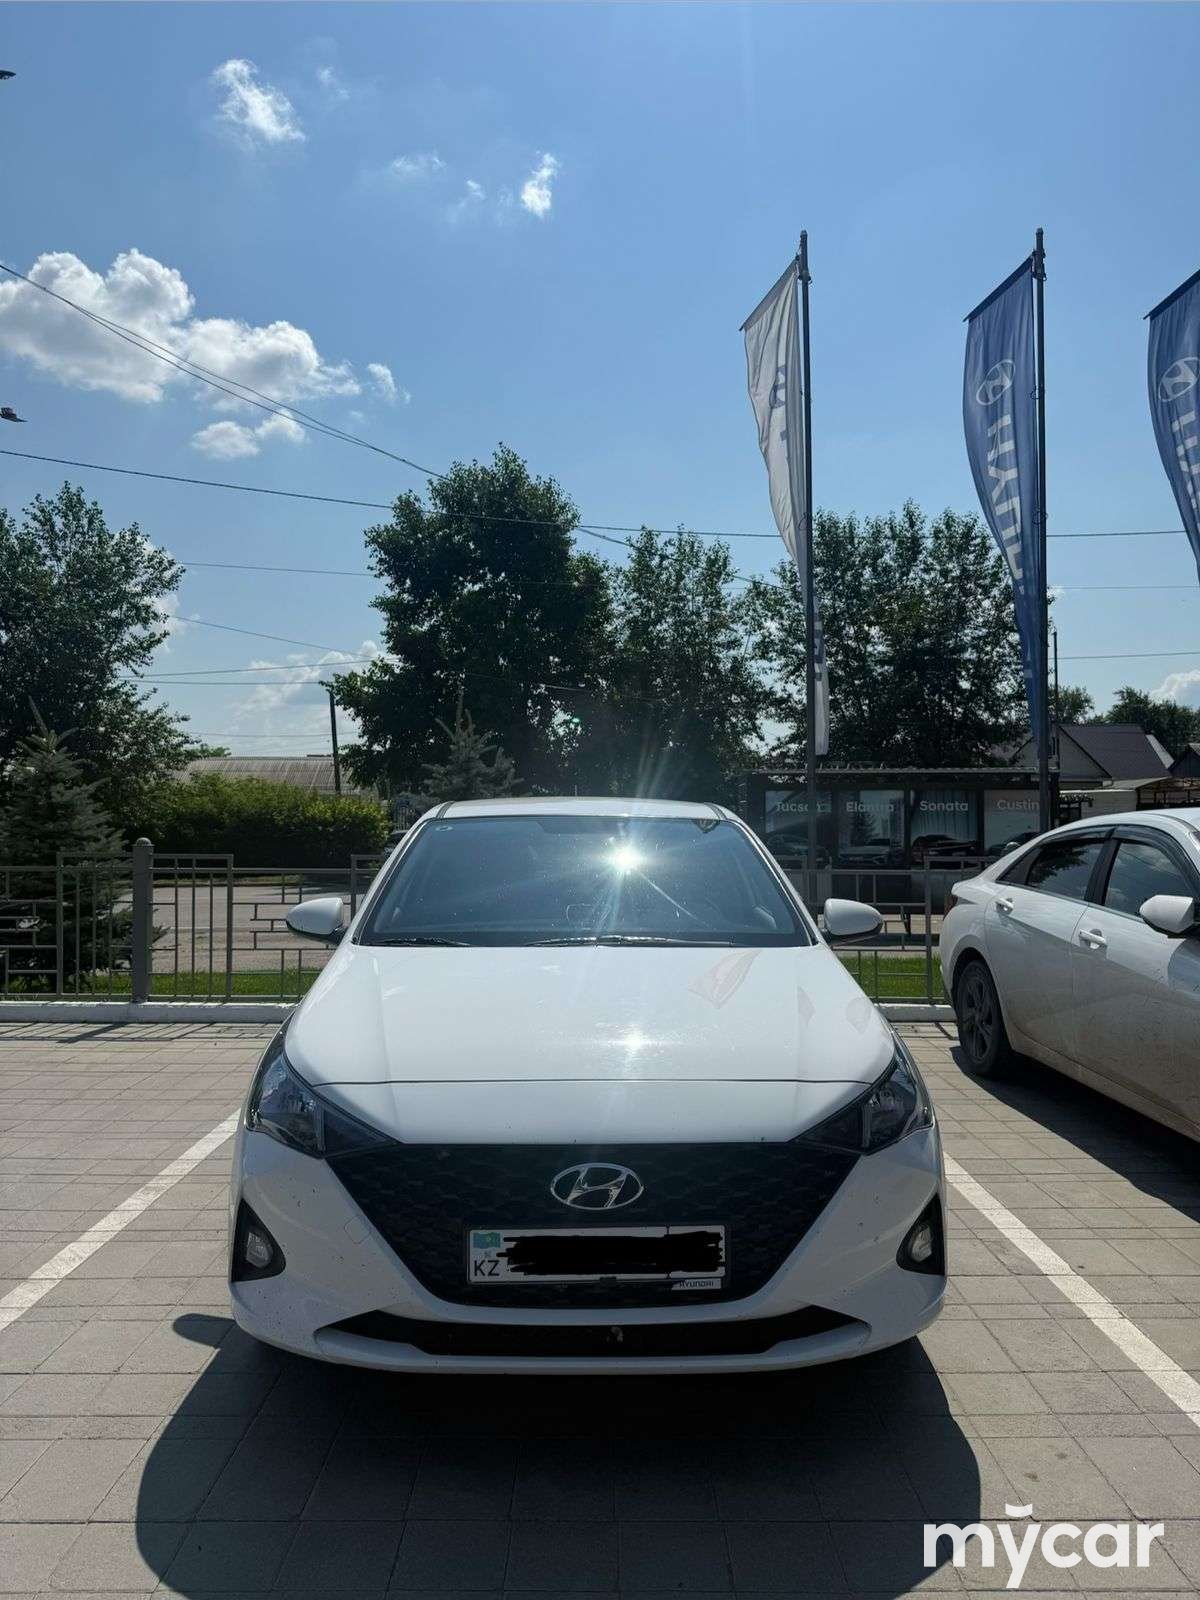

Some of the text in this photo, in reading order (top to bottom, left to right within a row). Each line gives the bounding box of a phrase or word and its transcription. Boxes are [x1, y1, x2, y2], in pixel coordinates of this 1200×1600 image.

[919, 800, 968, 812] Sonata
[997, 799, 1040, 811] Custin
[474, 1260, 499, 1276] KZ
